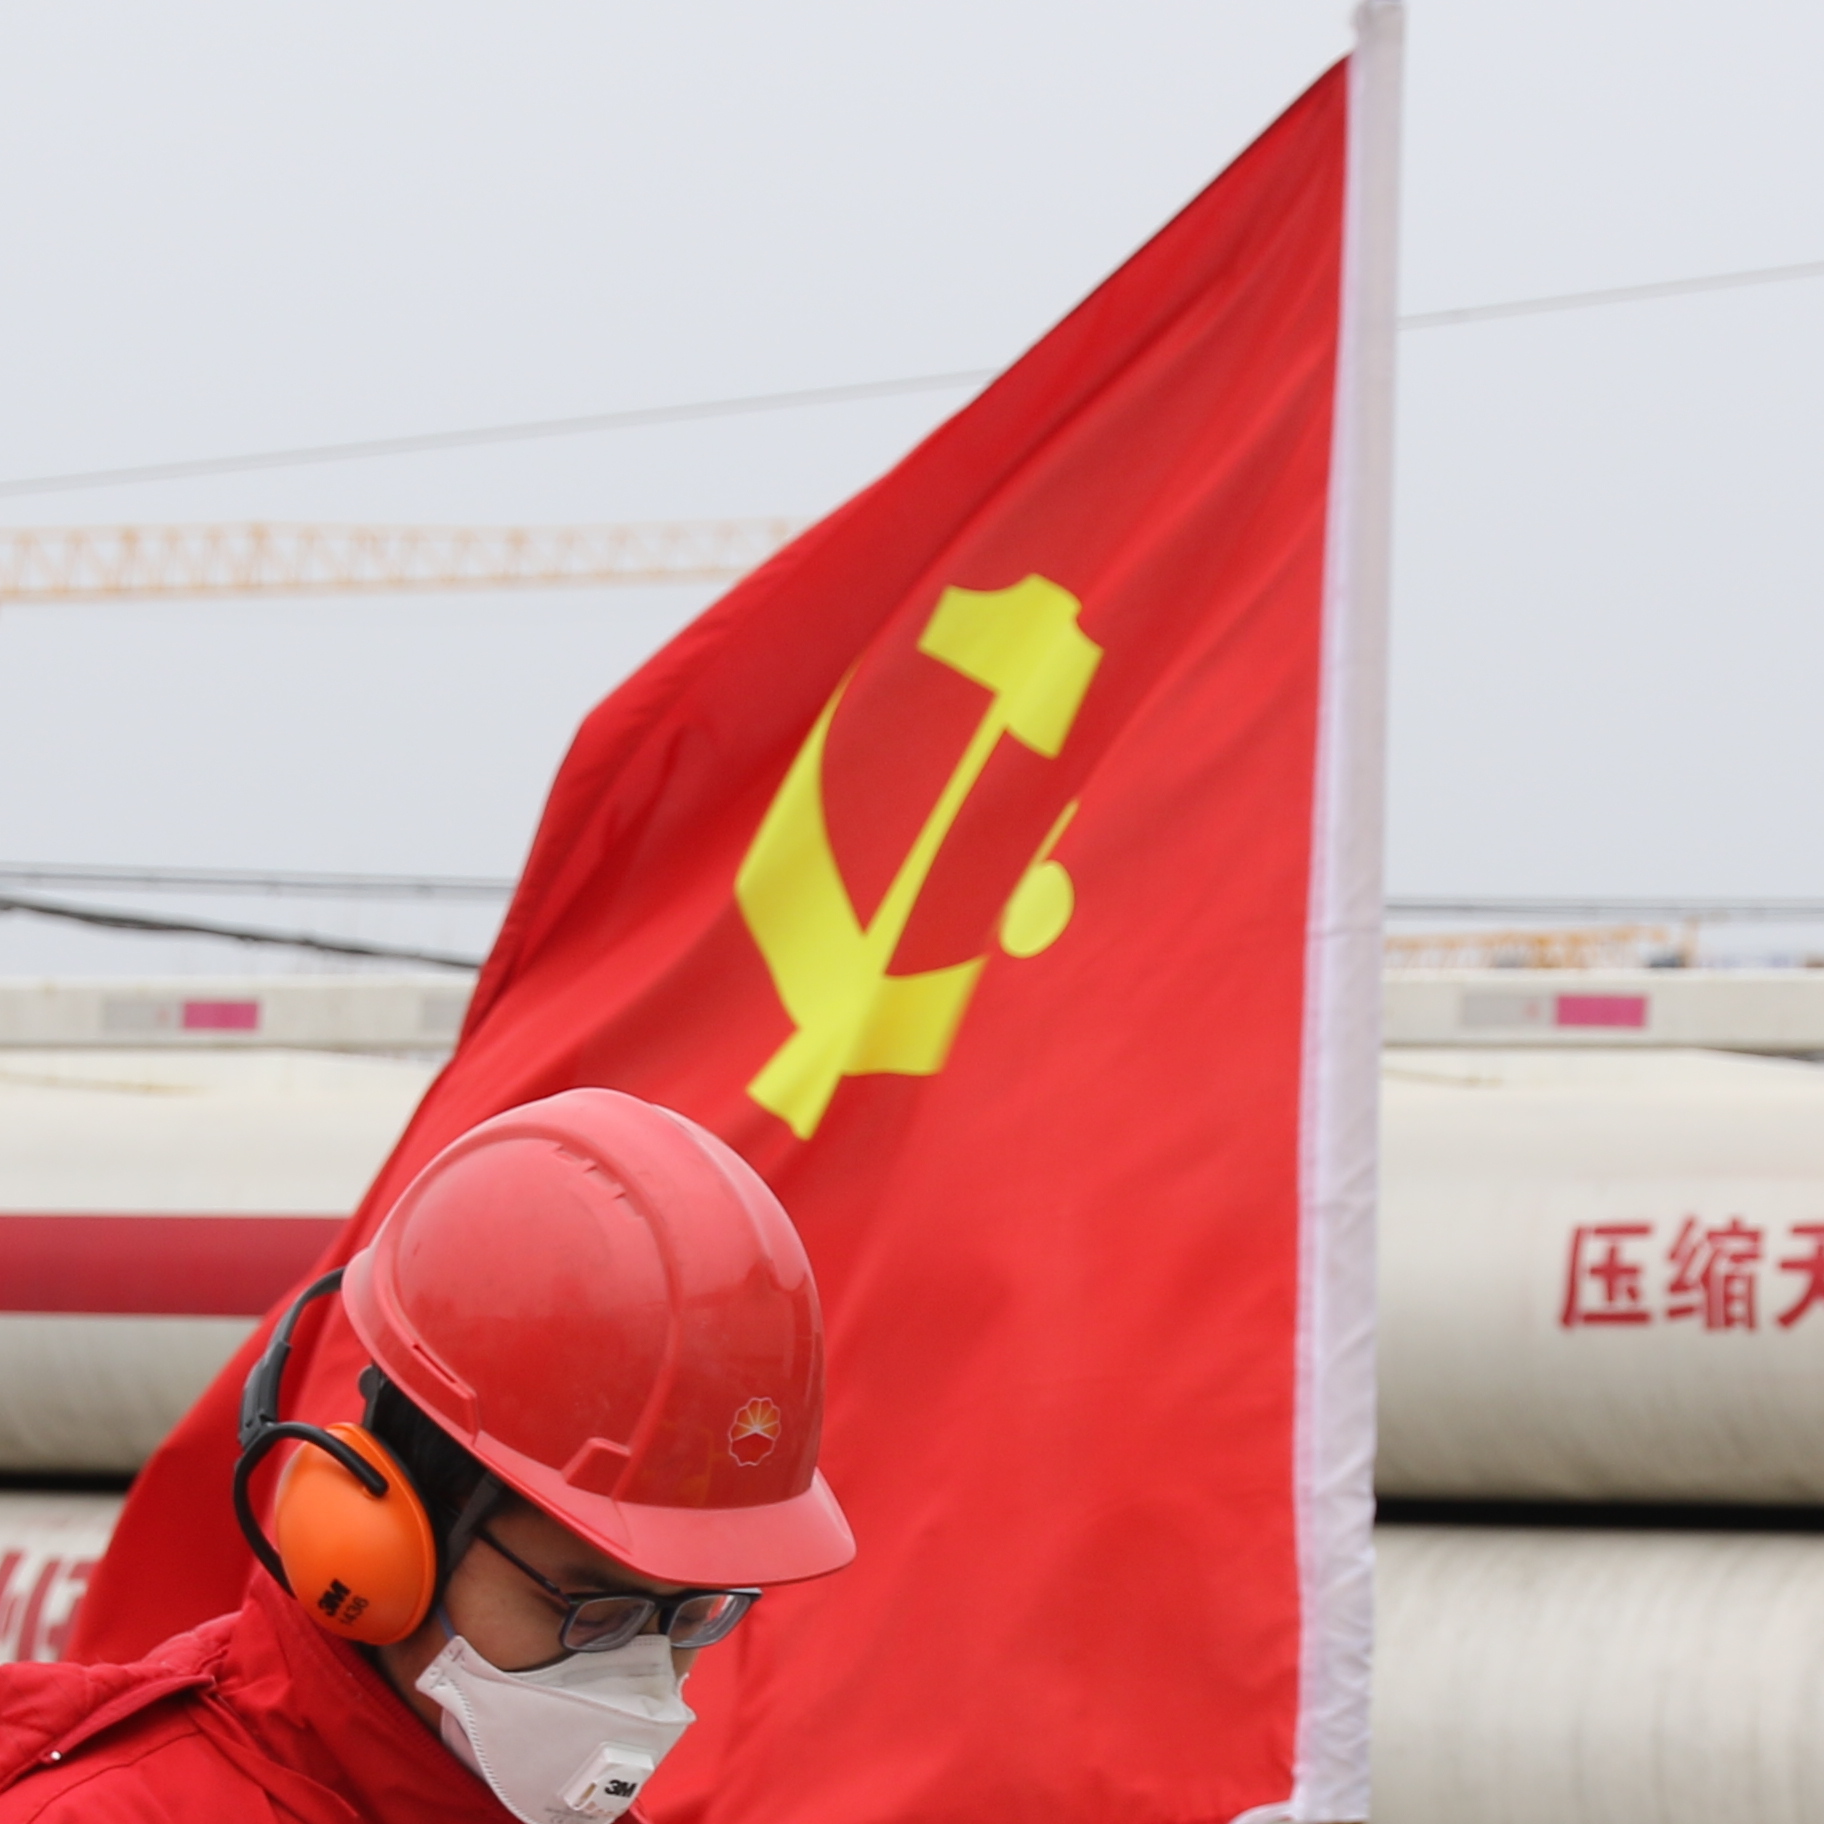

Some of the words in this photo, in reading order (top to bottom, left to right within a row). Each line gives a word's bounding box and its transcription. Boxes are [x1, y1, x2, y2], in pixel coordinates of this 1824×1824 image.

[318, 1579, 351, 1617] 3M
[339, 1596, 370, 1627] 1436
[604, 1779, 637, 1798] 3M
